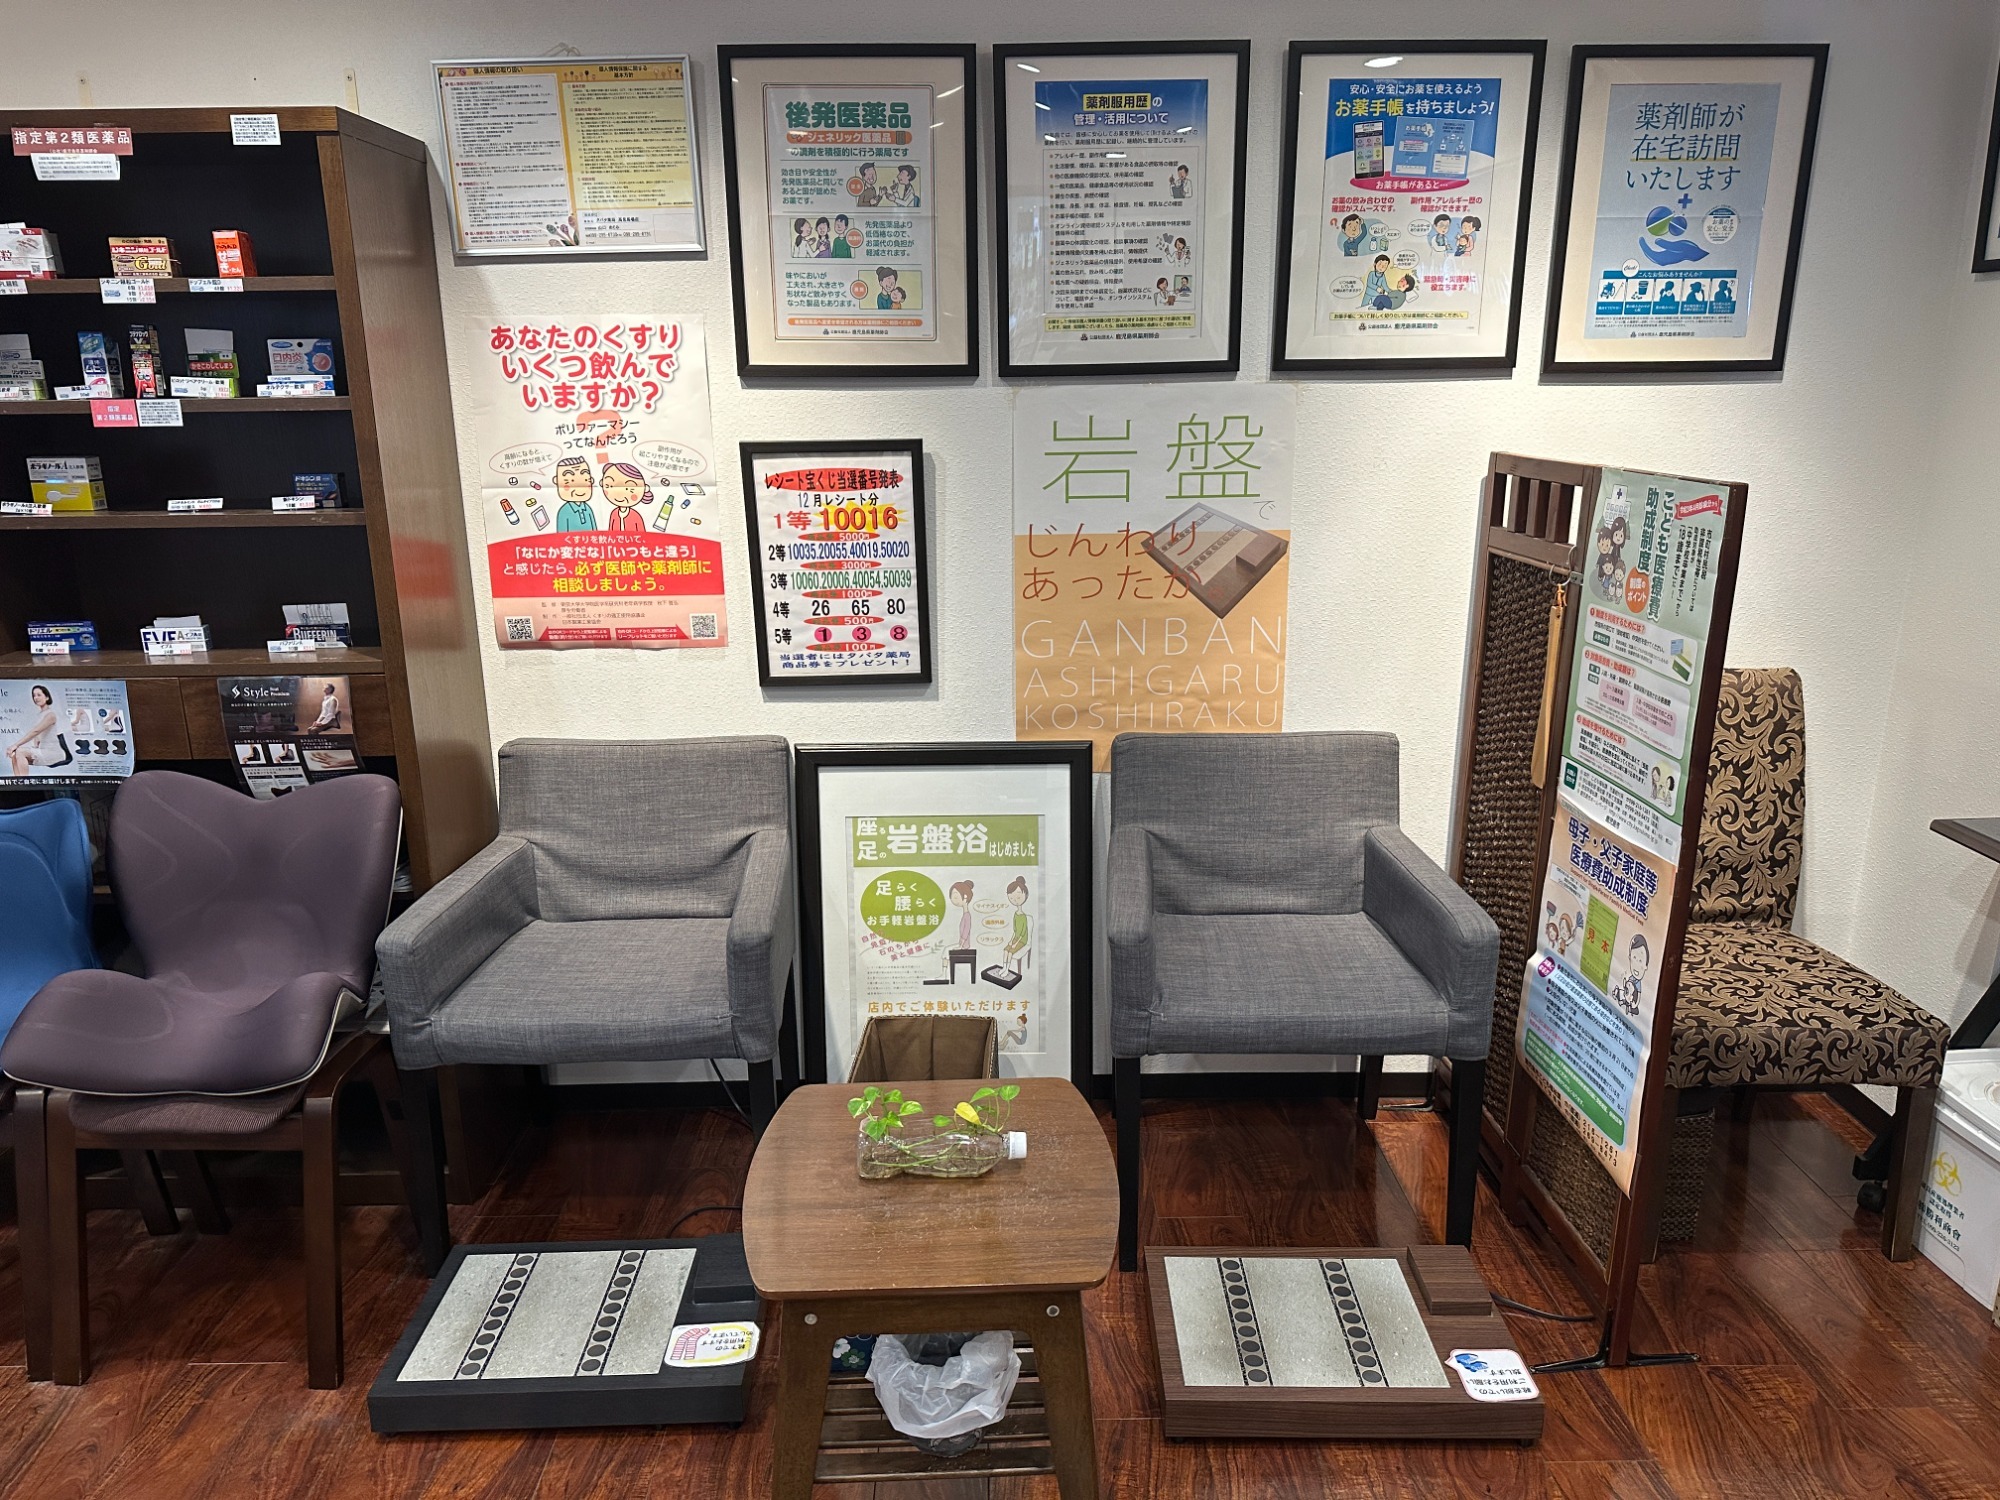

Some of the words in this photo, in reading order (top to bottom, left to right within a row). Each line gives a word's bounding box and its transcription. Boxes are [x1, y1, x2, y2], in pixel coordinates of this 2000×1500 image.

[1350, 84, 1482, 94] 安心・安全にお薬を使えるよう
[1086, 96, 1162, 108] 薬剤服用歴の
[786, 102, 912, 128] 後発医薬品
[1074, 113, 1168, 125] 管理・活用について
[1635, 102, 1745, 131] 薬剤師が
[15, 131, 130, 145] 指定第2類医薬品
[808, 132, 891, 143] ジェネリック医薬品
[791, 148, 909, 157] の調剤を積極的に行う薬局です
[1632, 134, 1741, 162] 在宅訪問
[781, 168, 836, 176] 効き目や安全性が
[1626, 166, 1741, 191] いたします
[781, 178, 843, 186] 先発医薬品と同じで
[865, 230, 911, 238] 低価格なので、
[866, 249, 910, 257] 軽減されます。
[1431, 284, 1467, 292] 役立ちます。
[491, 324, 679, 351] あなたのくすり
[273, 353, 303, 363] 口内炎
[502, 353, 675, 379] いくつ飲んで
[523, 382, 660, 410] いますか?
[96, 413, 134, 422] 第2類医薬品
[555, 420, 640, 436] ポリファーマシー
[563, 433, 637, 449] ってなんだろう
[639, 451, 700, 466] 起こりやすくなるので
[647, 460, 689, 473] 注意が必要です
[766, 470, 900, 489] レシート宝くじ当選番号発表
[774, 511, 811, 530] 1等
[821, 507, 898, 530] 10016
[839, 532, 870, 541] 5000円
[1637, 486, 1660, 572] 助成制度
[564, 535, 646, 544] くすりを飲んでいて、
[1030, 521, 1197, 558] じんわり
[515, 546, 697, 559] 「なにか変だな」「いつもと違う」
[769, 545, 786, 561] 2等
[788, 542, 910, 560] 10035.20055.40019.50020
[1647, 490, 1675, 621] こども医療費
[503, 560, 712, 576] と感じたら、必ず医師や薬剤師に
[841, 561, 872, 569] 3000円
[553, 578, 665, 593] 相談しましょう。
[770, 573, 787, 590] 3等
[791, 570, 912, 589] 10060.20006.40054.50039
[842, 590, 873, 598] 1000円
[1626, 590, 1646, 603] ポイント
[773, 602, 790, 617] 4等
[811, 600, 830, 616] 26
[851, 599, 870, 615] 65
[887, 598, 905, 614] 80
[844, 616, 874, 624] 500円
[775, 629, 792, 645] 5等
[818, 629, 828, 641] 1
[856, 628, 866, 641] 3
[893, 627, 905, 640] 8
[1021, 615, 1281, 658] GANBAN
[846, 643, 875, 651] 100円
[780, 651, 910, 660] 当選者にはタバタ薬局
[1024, 664, 1280, 698] ASHIGARU
[244, 688, 269, 698] Style
[1025, 701, 1277, 730] KOSHIRAKU
[887, 823, 988, 854] 岩盤浴
[989, 842, 1035, 857] はじめました
[858, 841, 886, 860] 足の
[1567, 816, 1659, 896] 母子・父子家庭等
[1569, 842, 1649, 917] 医療費助成制度
[876, 880, 917, 896] 足らく
[895, 896, 936, 911] 腰らく
[867, 915, 939, 926] お手軽岩盤浴
[1587, 926, 1610, 956] 見本
[891, 943, 930, 961] 美と健康に
[868, 1000, 1030, 1013] 店内でご体験いただけます
